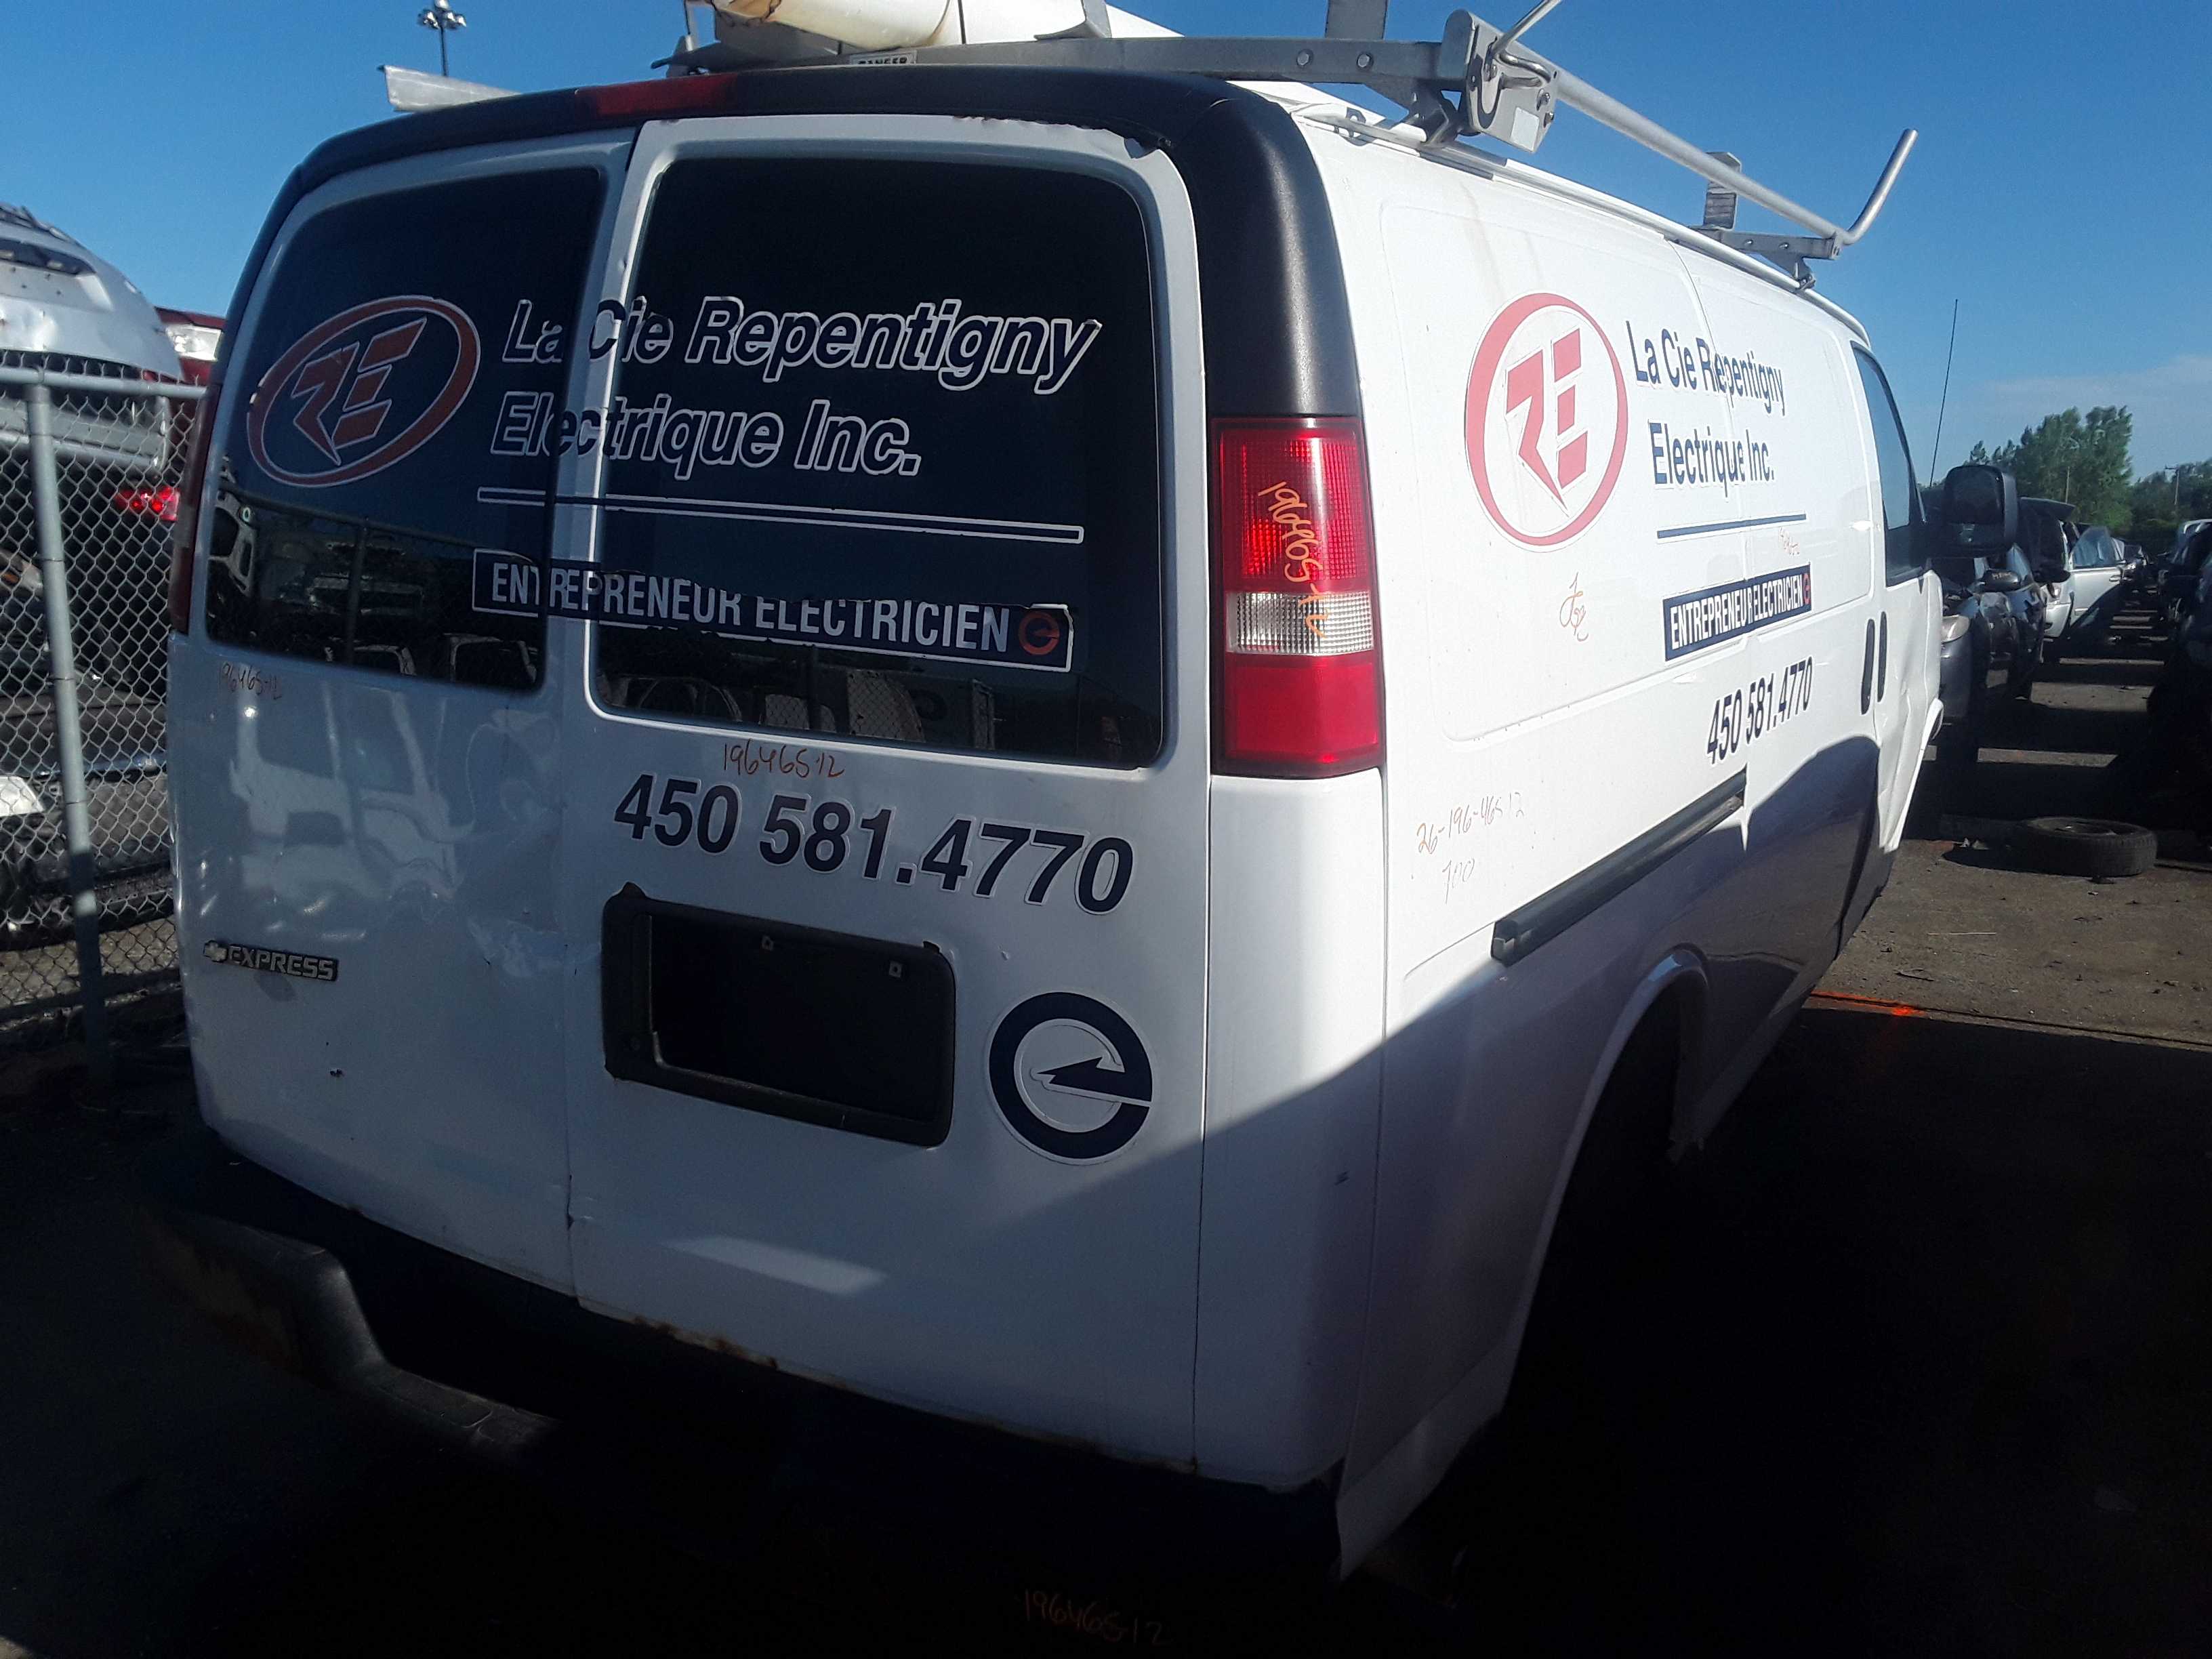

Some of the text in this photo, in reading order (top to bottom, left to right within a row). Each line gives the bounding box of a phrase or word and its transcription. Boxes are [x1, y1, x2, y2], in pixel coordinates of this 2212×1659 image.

[589, 295, 674, 364] Cie
[684, 295, 1103, 394] Repentigny
[1625, 320, 1786, 417] La Cie Repentigny
[490, 391, 922, 480] Electrique Inc.
[1648, 422, 1775, 498] Electrique Inc.
[492, 562, 1010, 653] ENTREPRENEUR ELECTRICIEN
[1670, 574, 1803, 651] ENTREPRENEUR ELECTRICIEN
[1707, 656, 1813, 764] 450 581.4770
[614, 773, 1134, 914] 450 581.4770
[228, 945, 334, 981] EXPRESS
